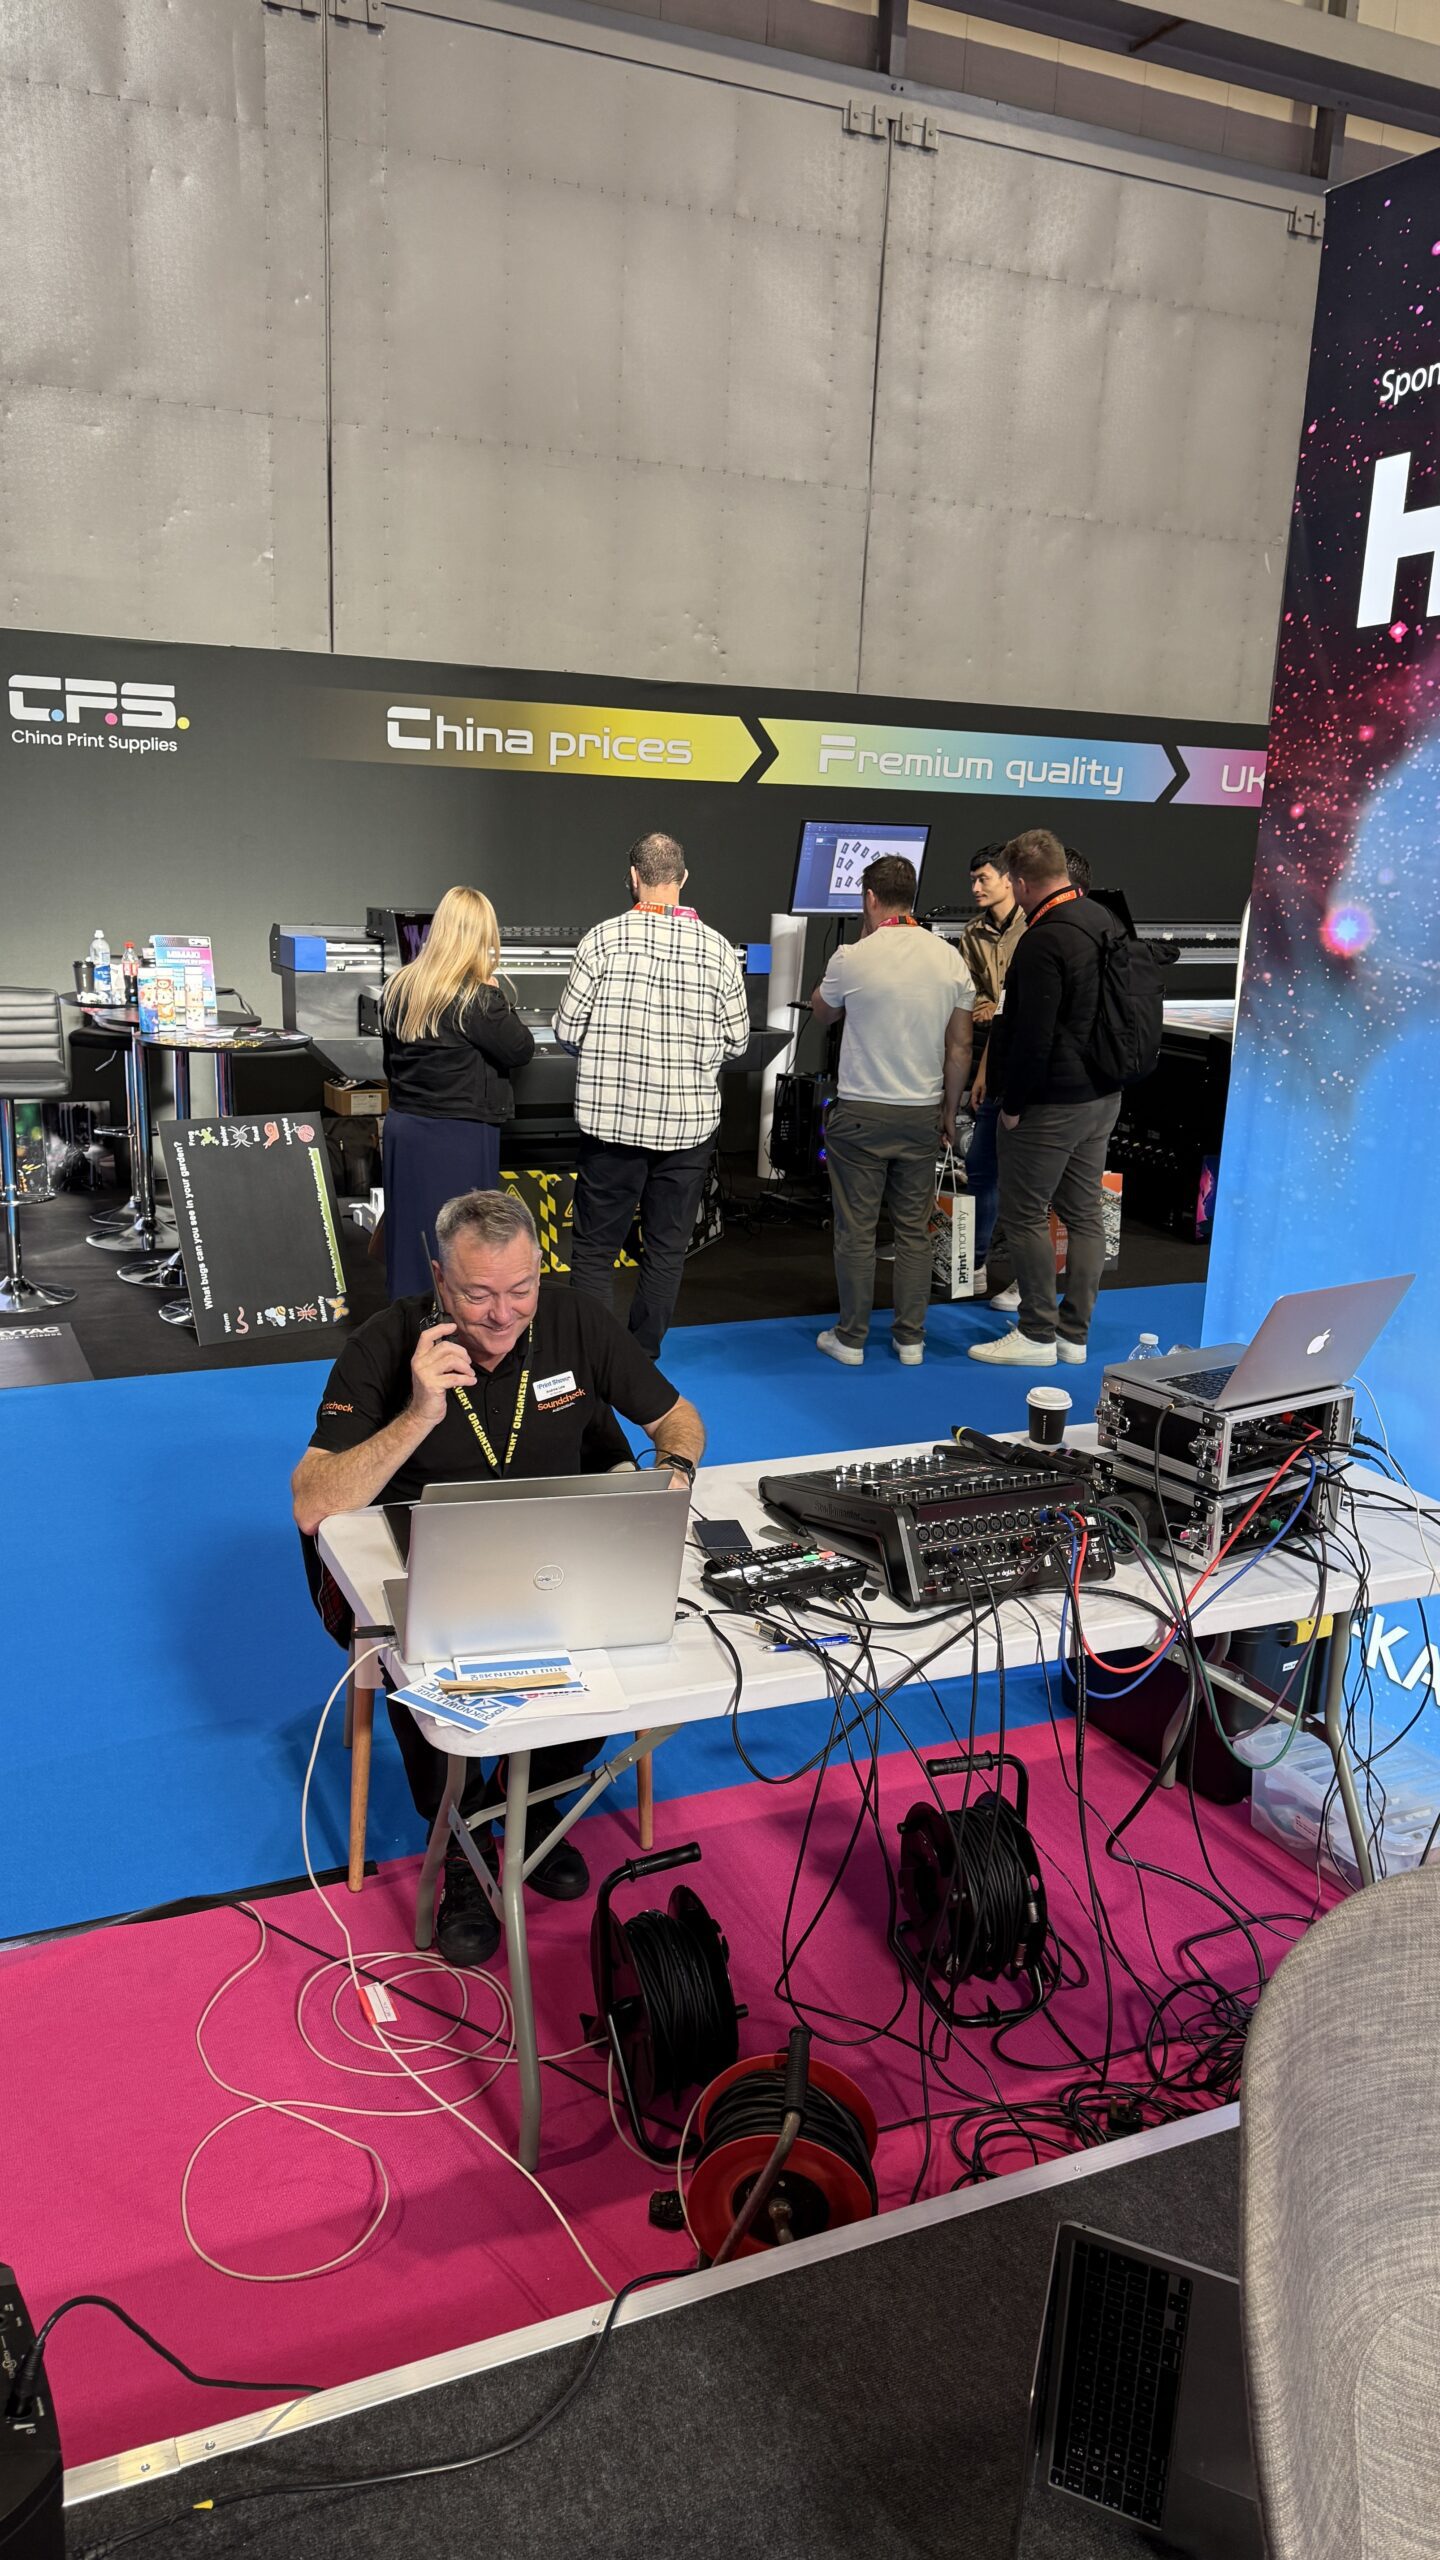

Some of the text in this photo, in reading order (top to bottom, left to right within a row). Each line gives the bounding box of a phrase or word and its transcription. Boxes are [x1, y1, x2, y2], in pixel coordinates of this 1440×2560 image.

[1380, 362, 1440, 406] Spon
[1356, 451, 1440, 628] H
[11, 729, 178, 755] China Print Supplies
[387, 705, 692, 766] China prices
[818, 734, 1124, 795] Premium quality
[1221, 765, 1266, 793] UK
[188, 1130, 196, 1146] Frog
[220, 1126, 229, 1146] Spider
[281, 1118, 292, 1146] Ladybird
[174, 1141, 214, 1310] What bugs can you see in your garden?
[957, 1210, 969, 1284] printmonthly
[223, 1312, 232, 1333] Worm
[256, 1312, 264, 1325] Bee
[288, 1308, 296, 1320] Ant
[318, 1295, 328, 1322] Butterfly
[537, 1388, 586, 1412] Soundcheck
[454, 1386, 498, 1467] VENT ORGANISER
[505, 1370, 530, 1464] EVENT ORGANISER
[413, 1687, 483, 1718] KNOWLEDGE
